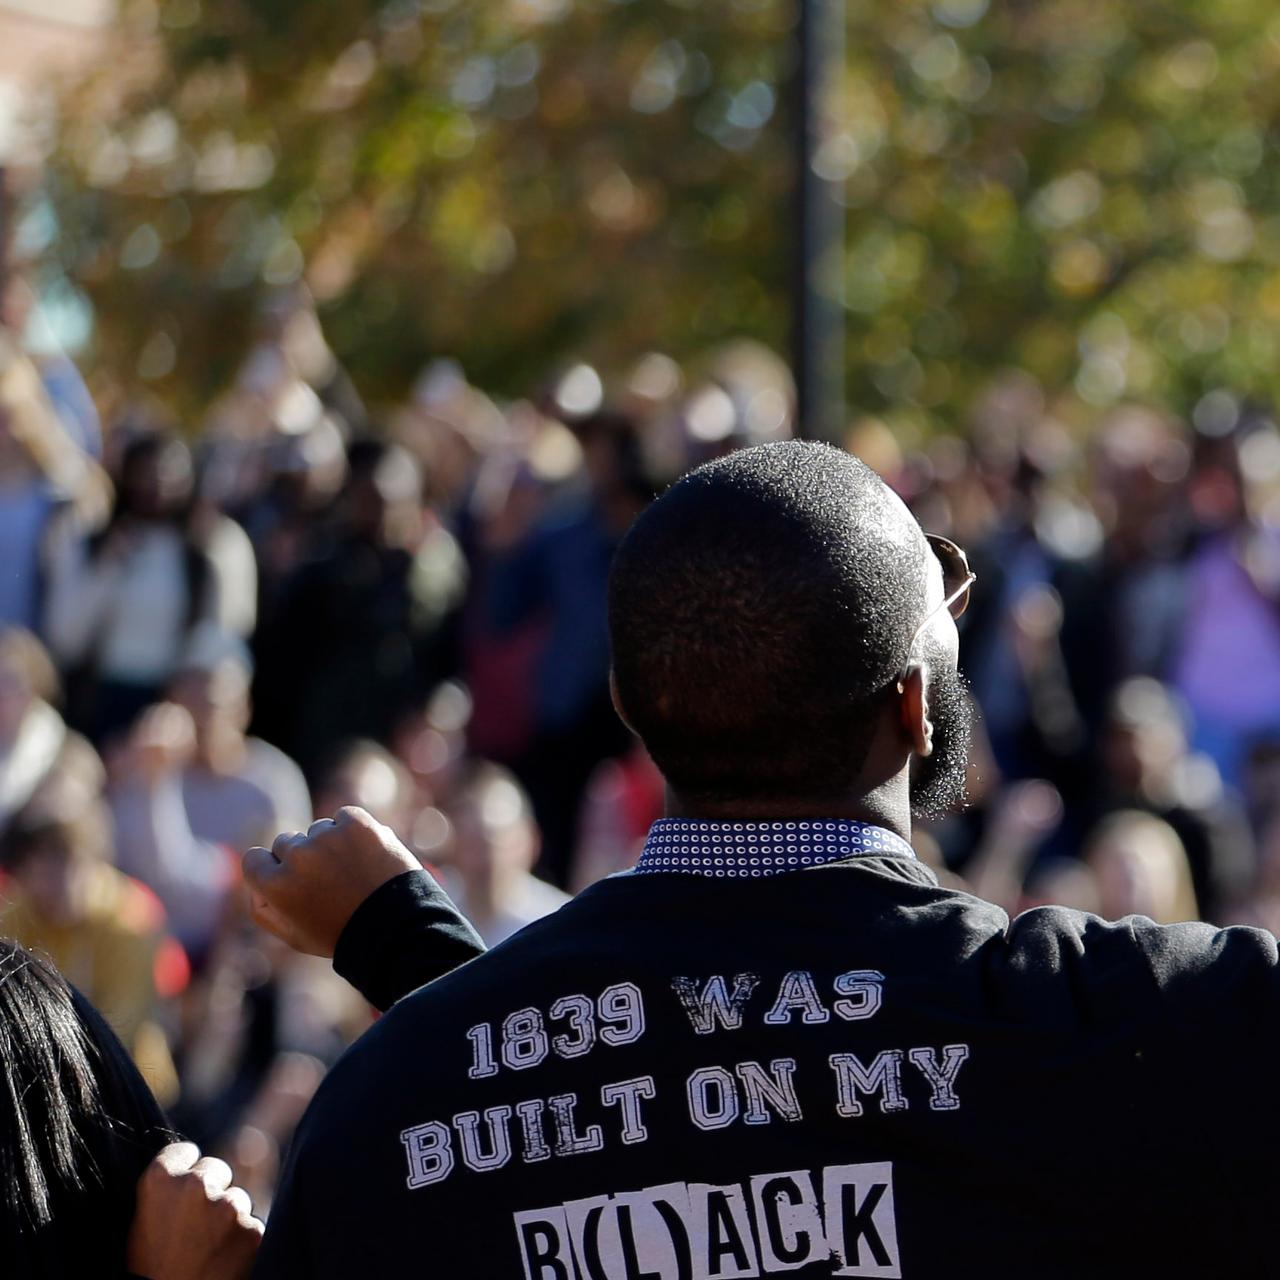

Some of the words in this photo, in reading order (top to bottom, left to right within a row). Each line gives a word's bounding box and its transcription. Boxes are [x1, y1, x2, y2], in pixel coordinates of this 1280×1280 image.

[468, 981, 646, 1079] 1839
[671, 968, 885, 1034] WAS
[401, 1076, 656, 1189] BUILT
[686, 1057, 803, 1130] ON
[829, 1044, 969, 1117] MY
